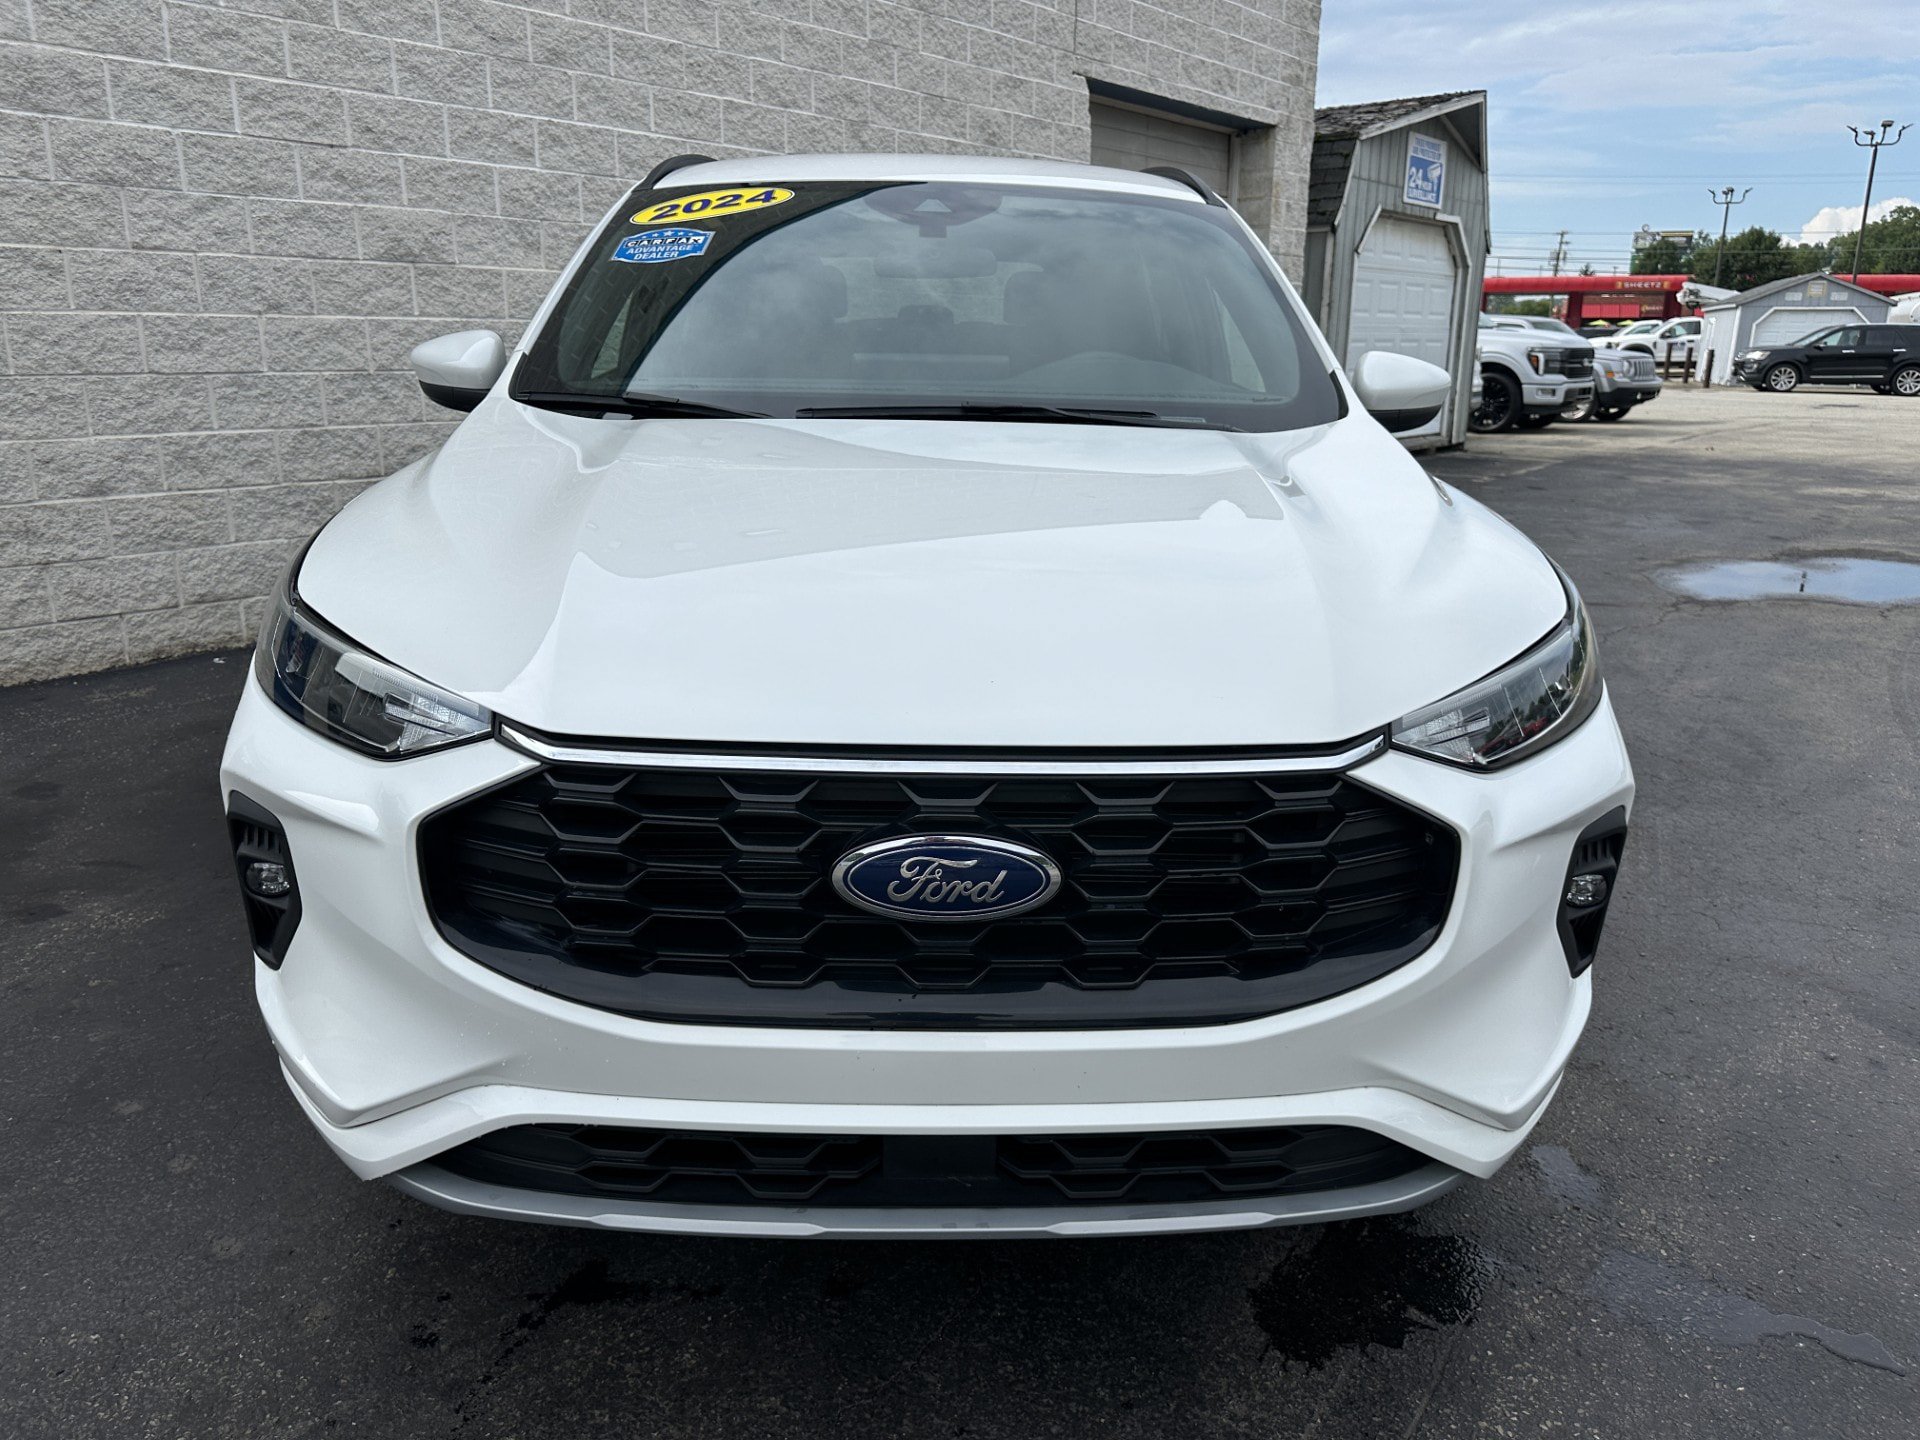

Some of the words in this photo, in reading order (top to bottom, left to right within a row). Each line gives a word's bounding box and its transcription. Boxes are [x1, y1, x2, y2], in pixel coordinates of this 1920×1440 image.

[1408, 166, 1423, 189] 24
[648, 189, 778, 222] 2024
[626, 235, 706, 247] CARFAX
[626, 244, 694, 255] ADVANTAGE
[633, 251, 680, 260] DEALER
[1623, 281, 1661, 289] SHEETZ
[887, 856, 1008, 903] Ford
